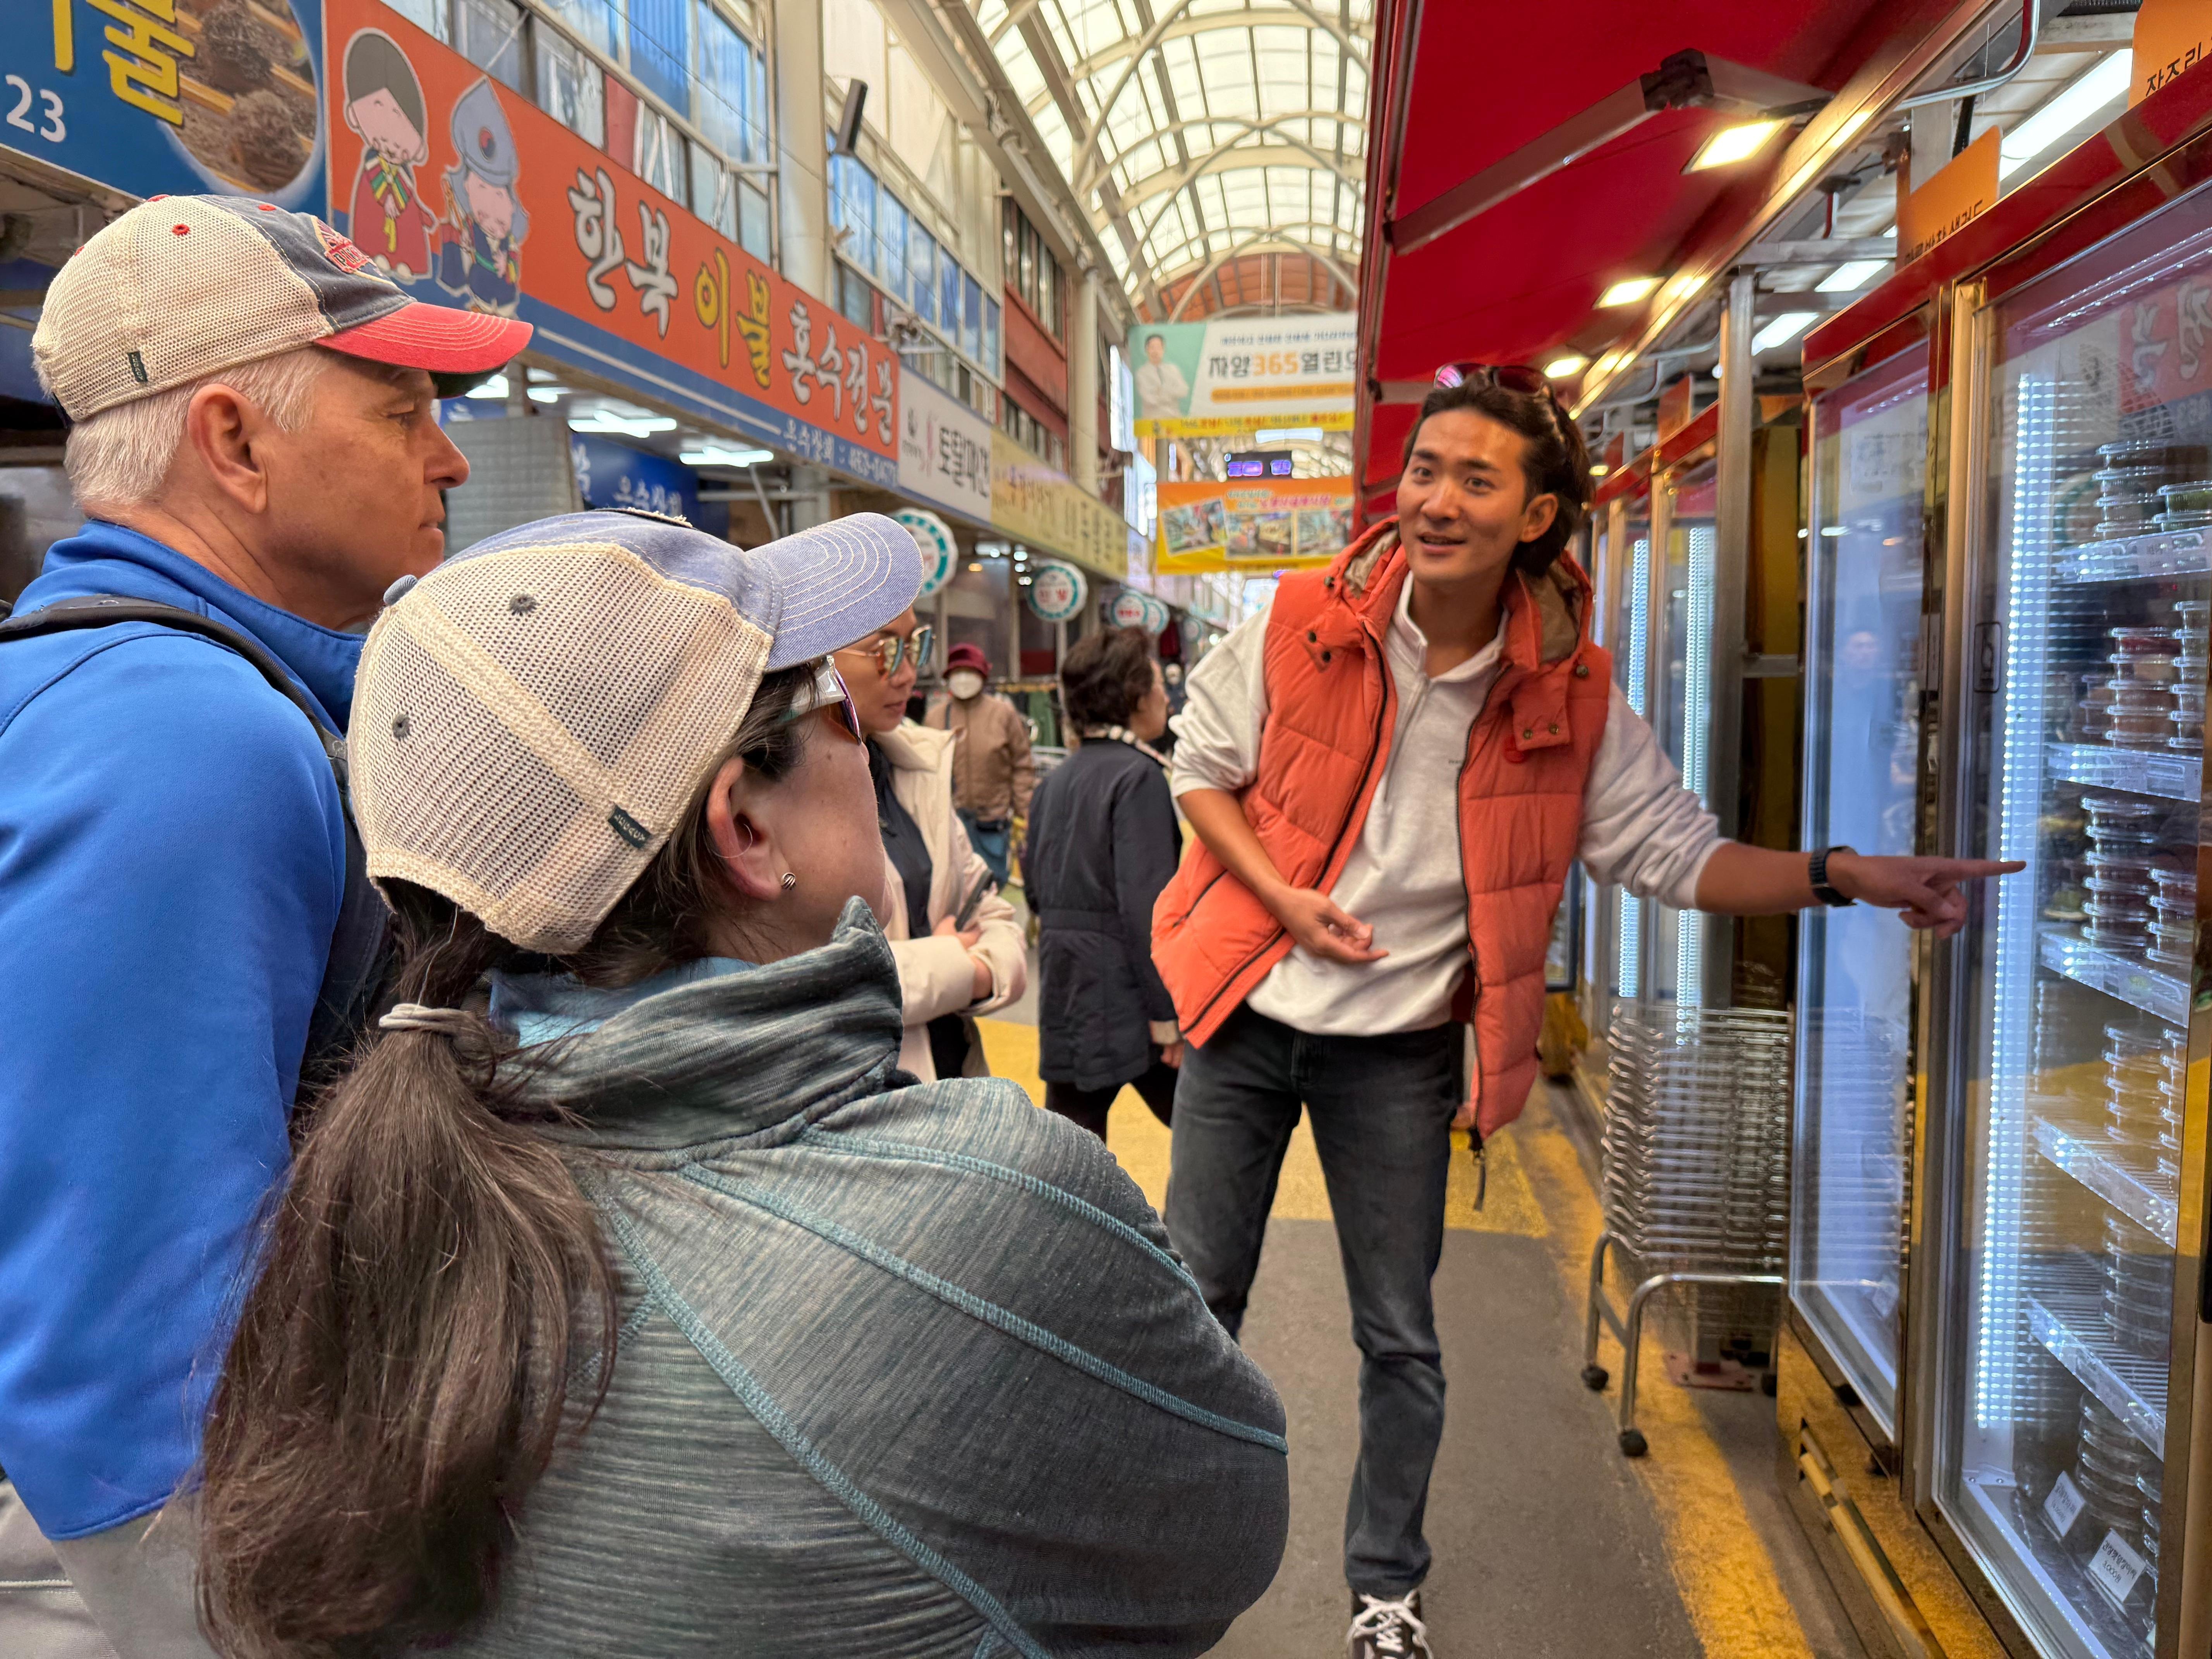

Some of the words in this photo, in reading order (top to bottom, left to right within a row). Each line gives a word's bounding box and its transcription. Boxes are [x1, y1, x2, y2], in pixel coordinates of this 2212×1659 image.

[5, 74, 66, 143] 23
[567, 166, 678, 339] 한복
[694, 246, 771, 390] 이불
[781, 299, 893, 445] 혼수전문
[614, 814, 646, 842] LEGACY
